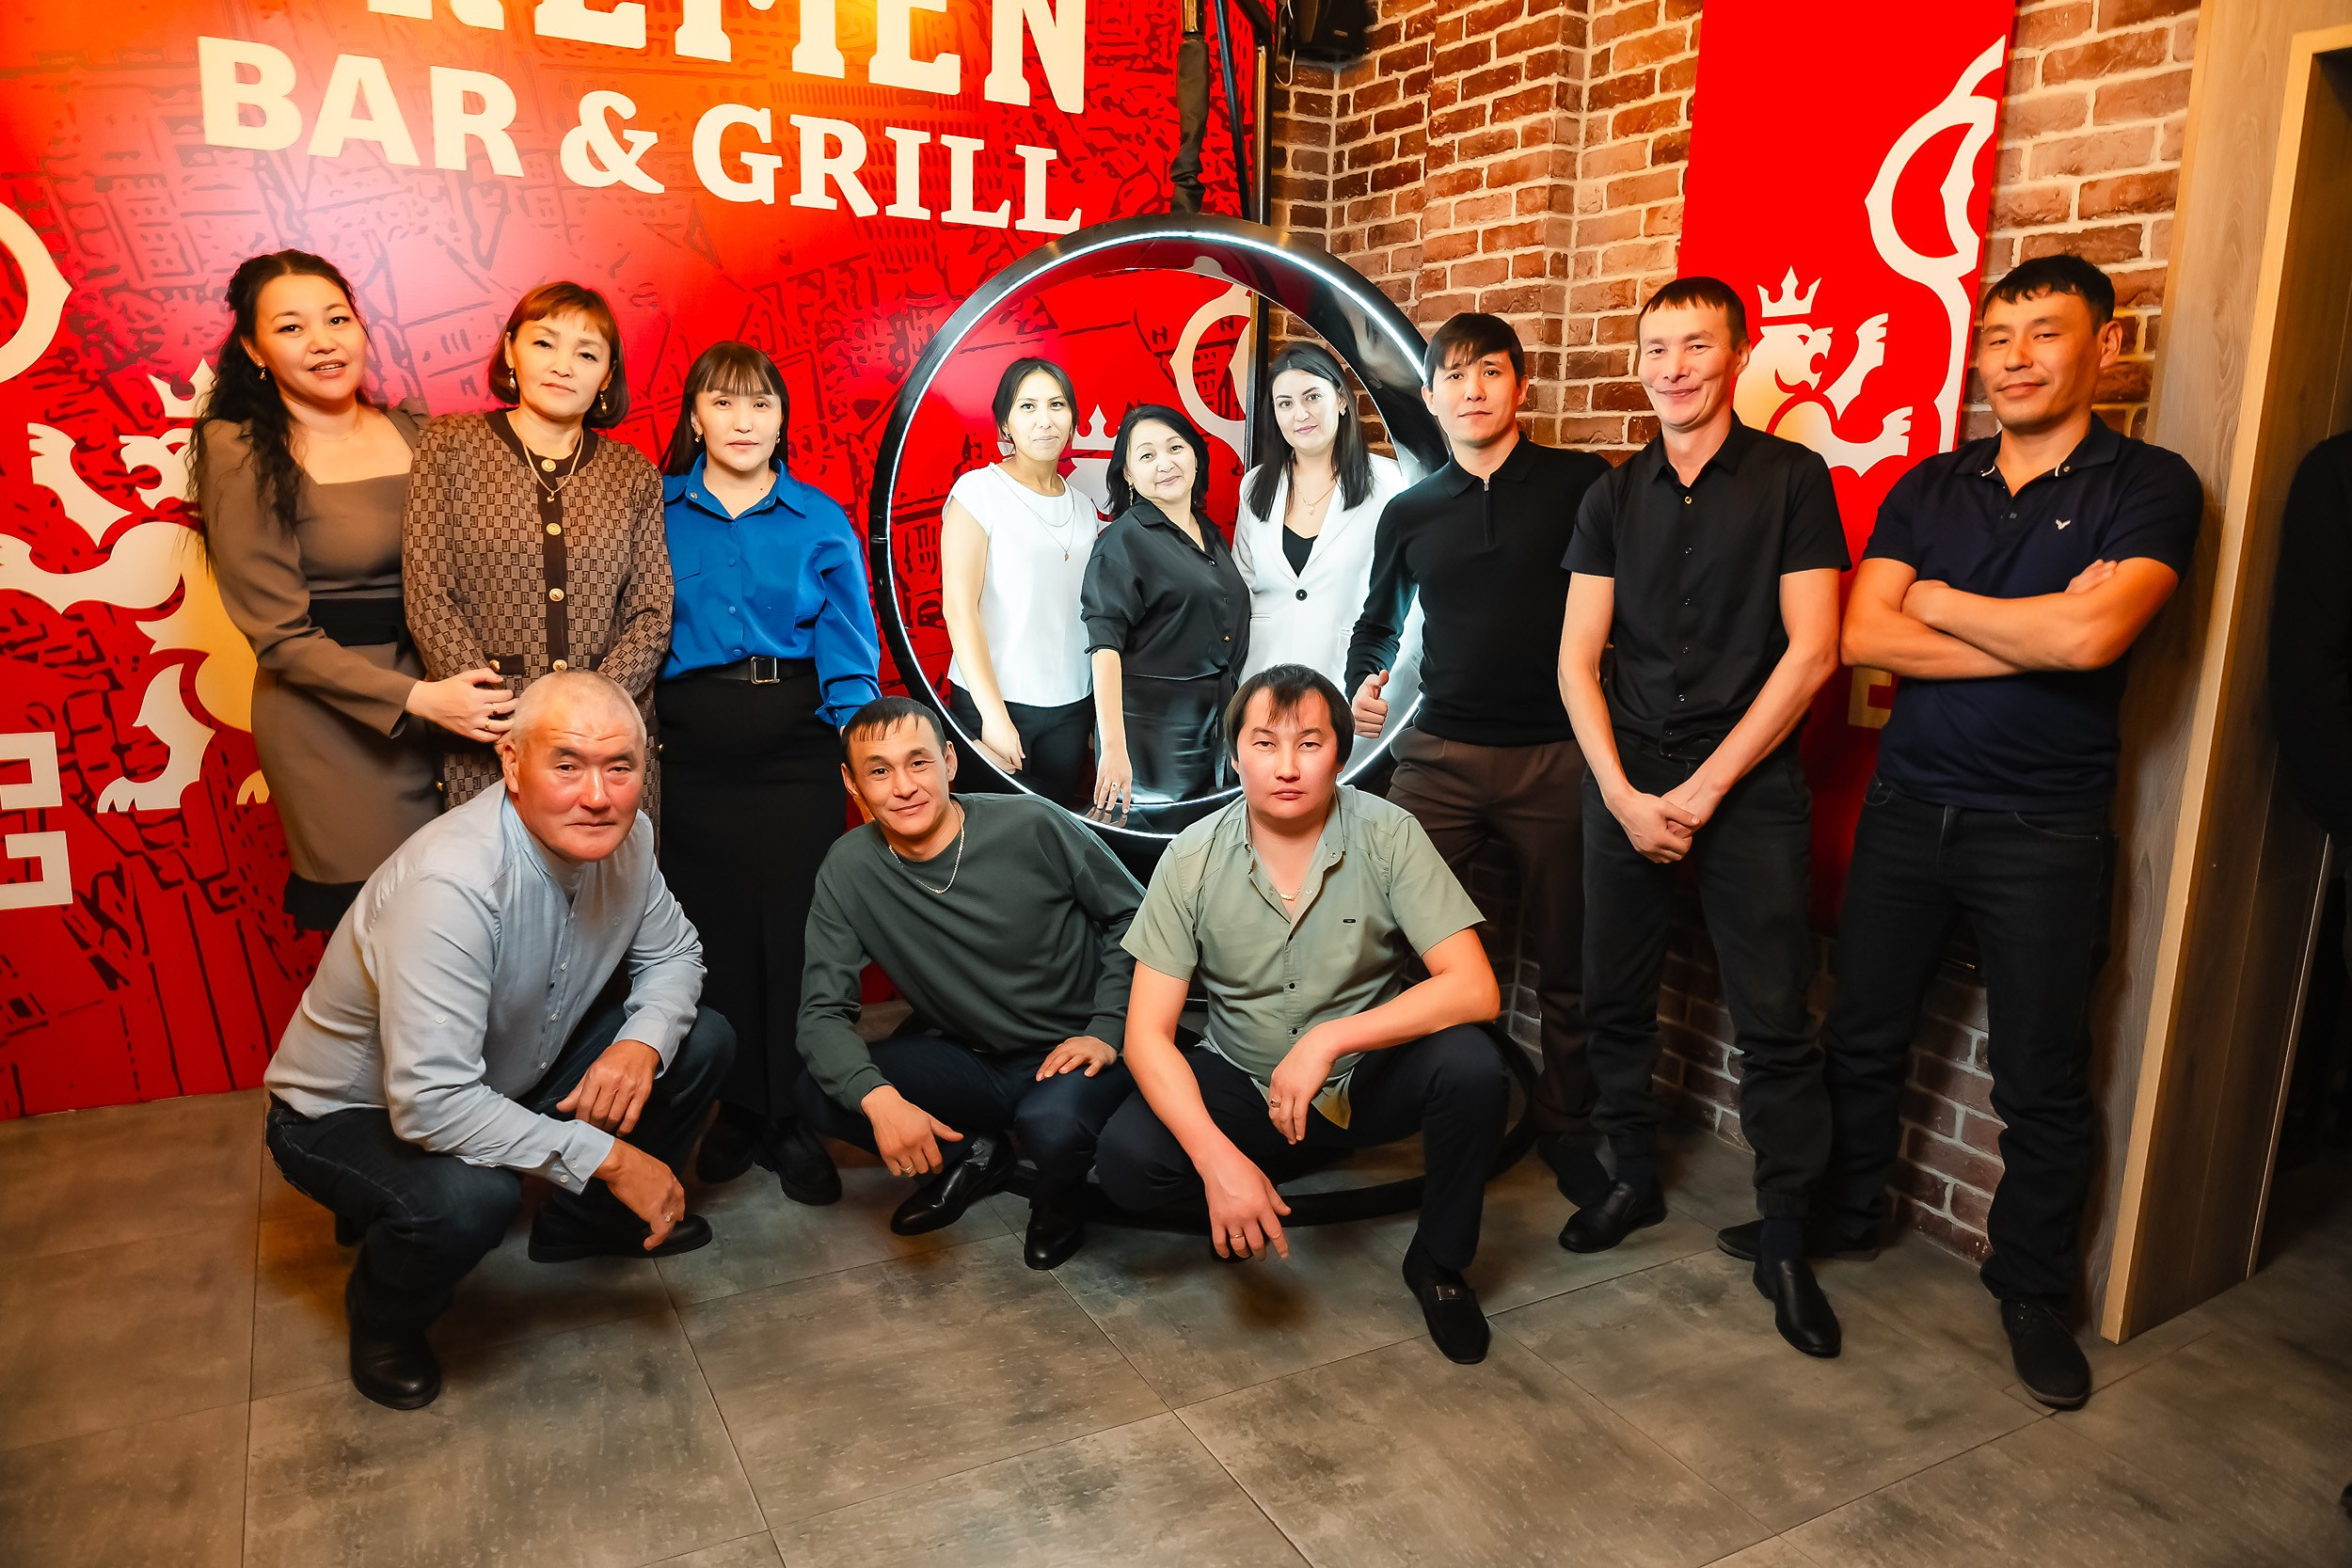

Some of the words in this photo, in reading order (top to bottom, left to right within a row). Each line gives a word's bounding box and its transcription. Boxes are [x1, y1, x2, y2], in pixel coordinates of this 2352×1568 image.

[198, 36, 524, 178] BAR
[560, 90, 664, 194] &
[691, 103, 1083, 235] GRILL
